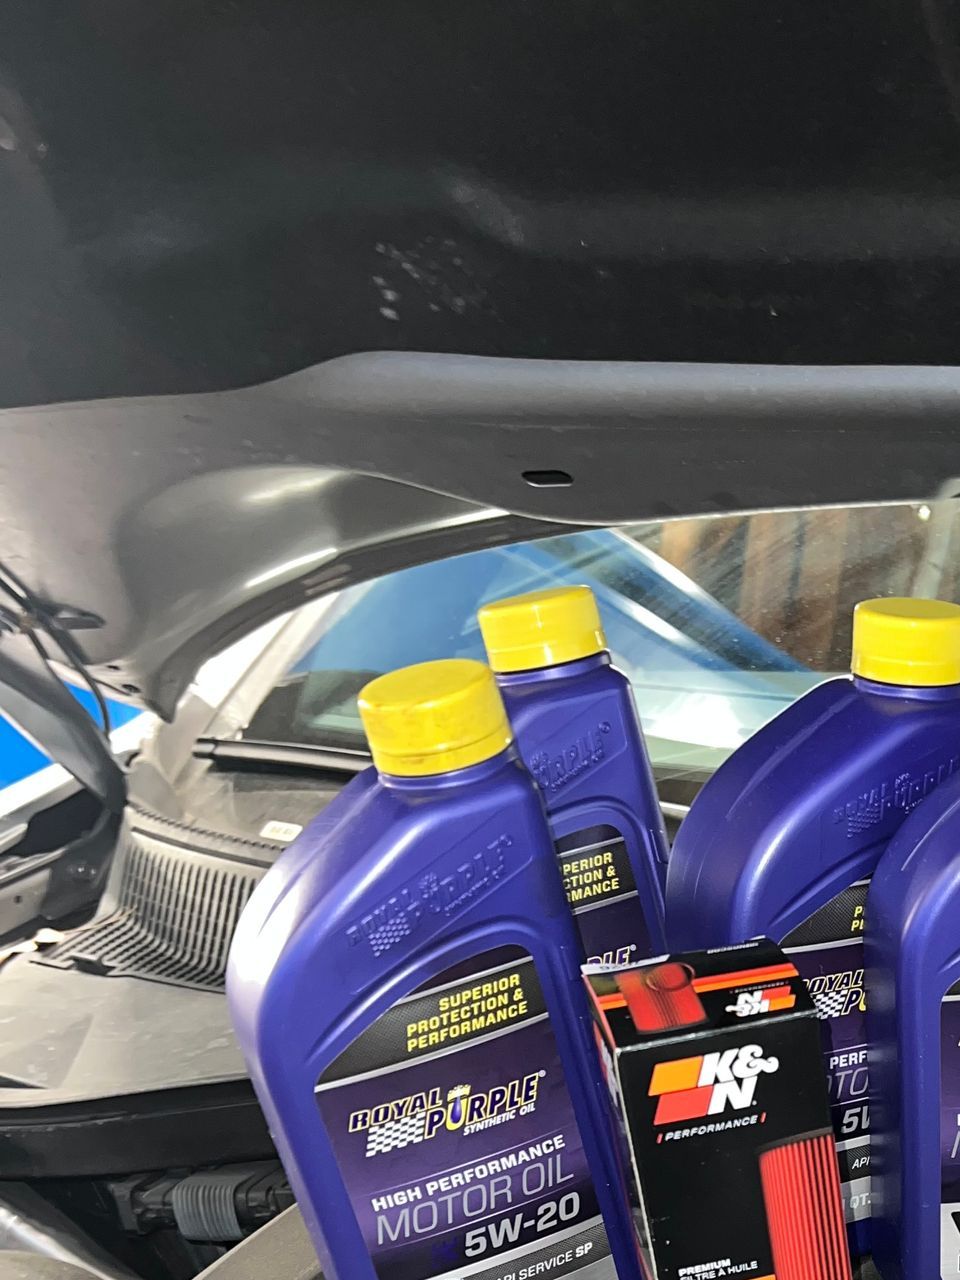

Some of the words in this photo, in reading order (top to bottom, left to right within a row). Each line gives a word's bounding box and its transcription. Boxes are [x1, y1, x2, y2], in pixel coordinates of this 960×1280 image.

[606, 865, 616, 877] &
[407, 993, 508, 1037] PROTECTION
[513, 988, 524, 1001] &
[439, 974, 520, 1012] SUPERIOR
[407, 1001, 528, 1052] PERFORMANCE
[348, 1087, 442, 1132] ROYAL
[424, 1072, 539, 1139] PURPLE
[463, 1109, 516, 1136] SYNTHETIC
[519, 1103, 536, 1117] OIL
[665, 1115, 759, 1141] PERFORMANCE
[371, 1186, 422, 1212] HIGH
[426, 1135, 566, 1196] PERFORMANCE
[377, 1176, 512, 1245] MOTOR
[522, 1154, 574, 1196] OIL
[465, 1192, 580, 1258] 5W-20
[519, 1250, 573, 1280] SERVICE
[575, 1242, 593, 1258] SP
[678, 1258, 731, 1277] PREMIUM
[727, 1260, 758, 1275] HUILE
